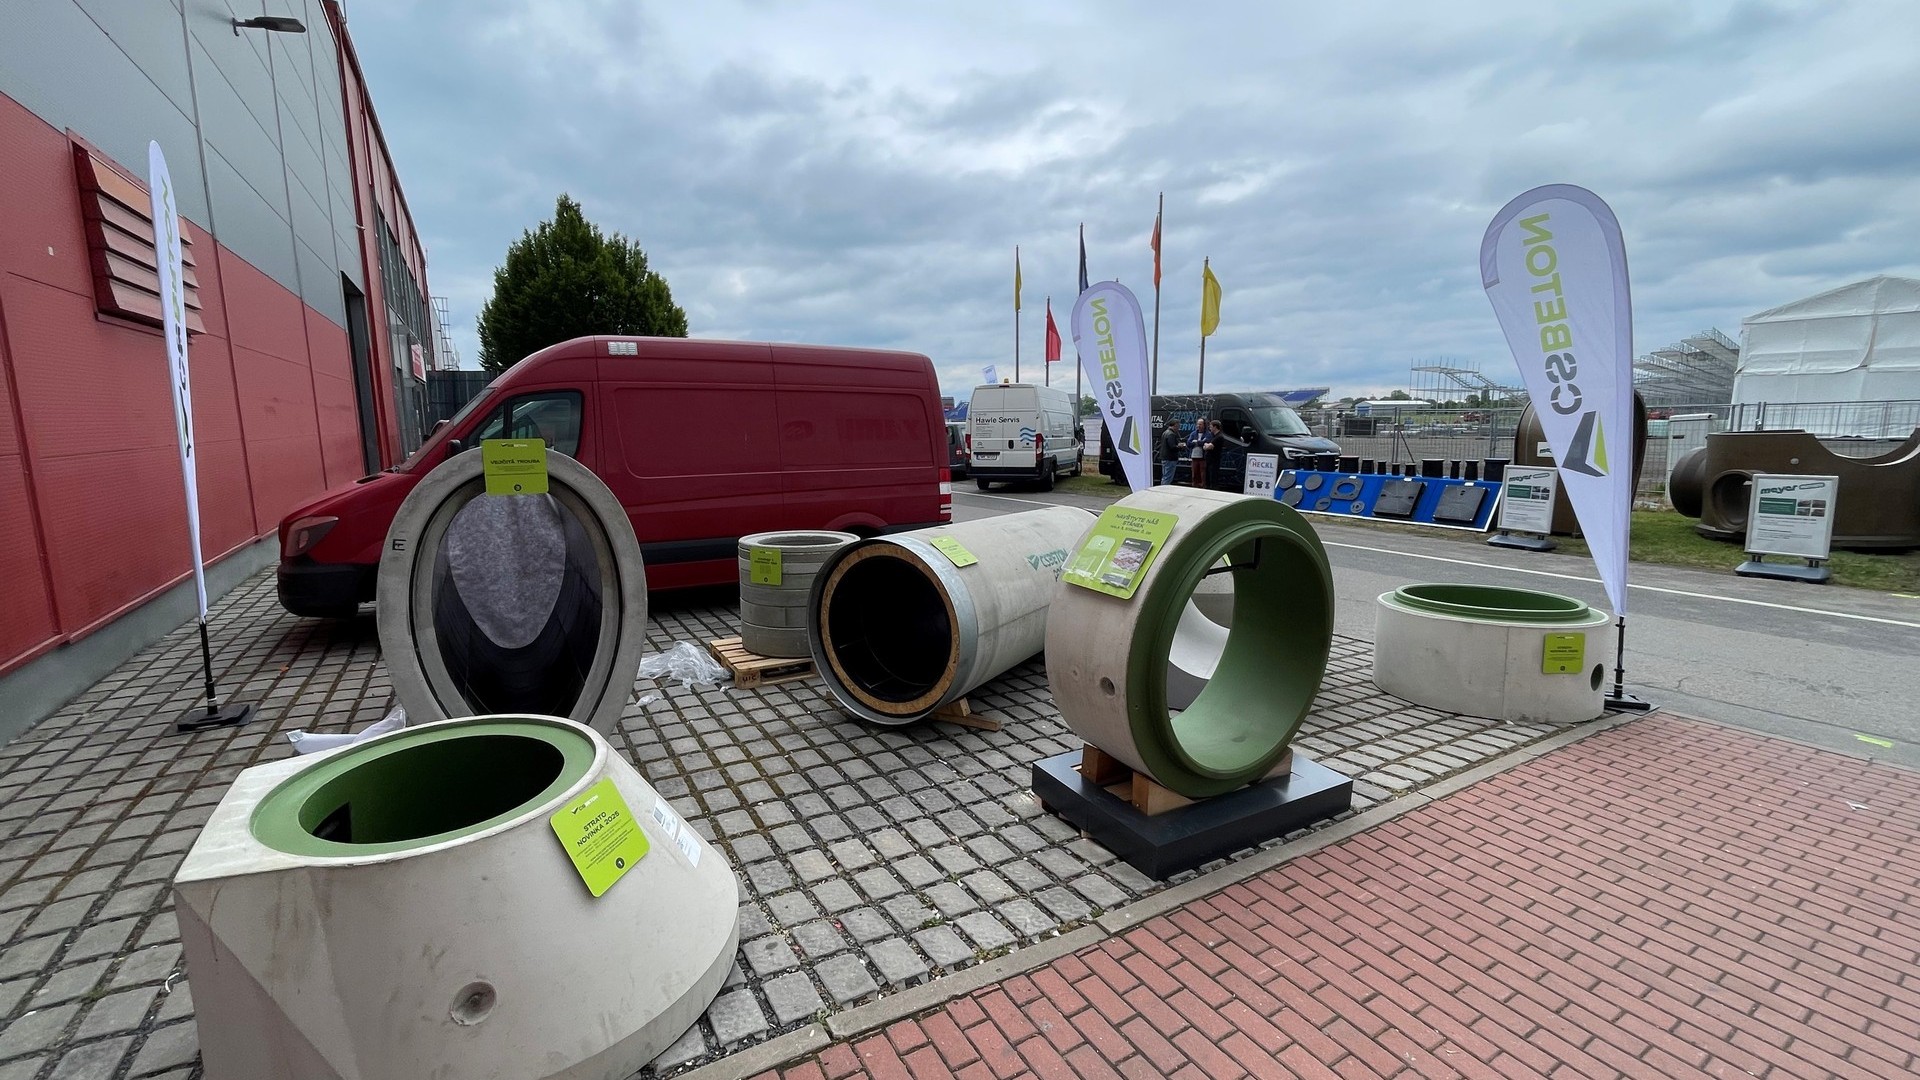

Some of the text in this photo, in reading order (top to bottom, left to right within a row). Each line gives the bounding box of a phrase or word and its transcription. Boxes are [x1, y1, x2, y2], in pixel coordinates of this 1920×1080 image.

[998, 416, 1020, 424] Servis
[1151, 415, 1164, 423] ITAL
[1760, 485, 1798, 494] meyer
[583, 811, 607, 832] STRATO
[576, 823, 604, 847] NOVINKA
